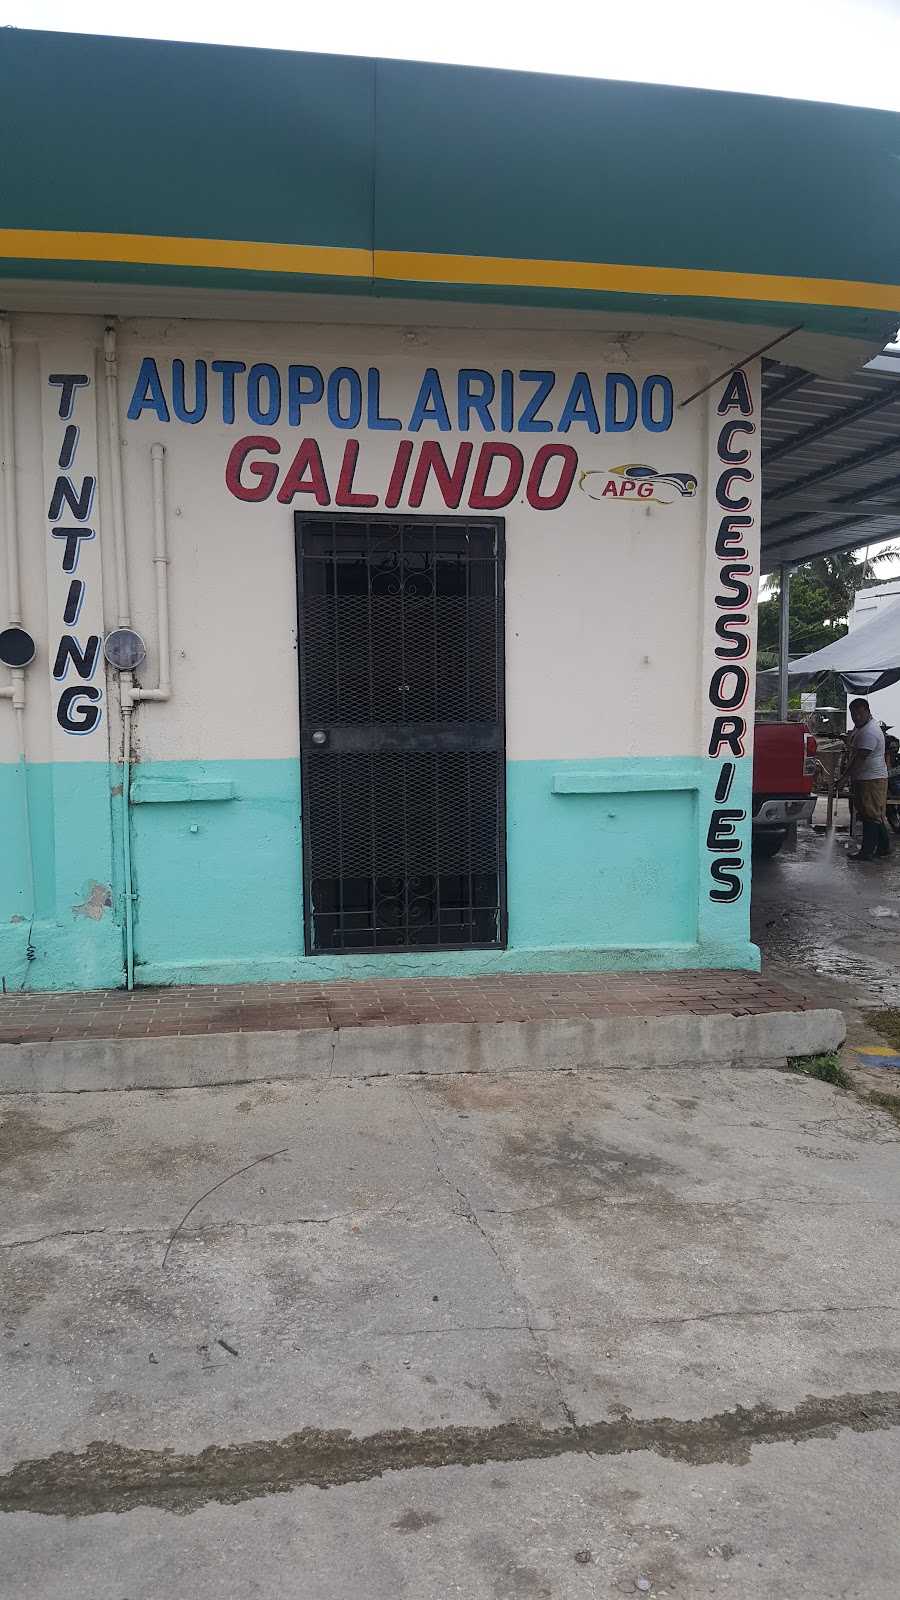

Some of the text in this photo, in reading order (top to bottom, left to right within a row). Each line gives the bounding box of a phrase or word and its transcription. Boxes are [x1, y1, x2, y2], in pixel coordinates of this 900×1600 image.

[127, 357, 674, 433] AUTOPOLARIZADO
[225, 434, 578, 511] GALINDO
[601, 480, 654, 498] APG
[48, 374, 103, 735] TINTING
[707, 371, 756, 904] ACCESSORIES
